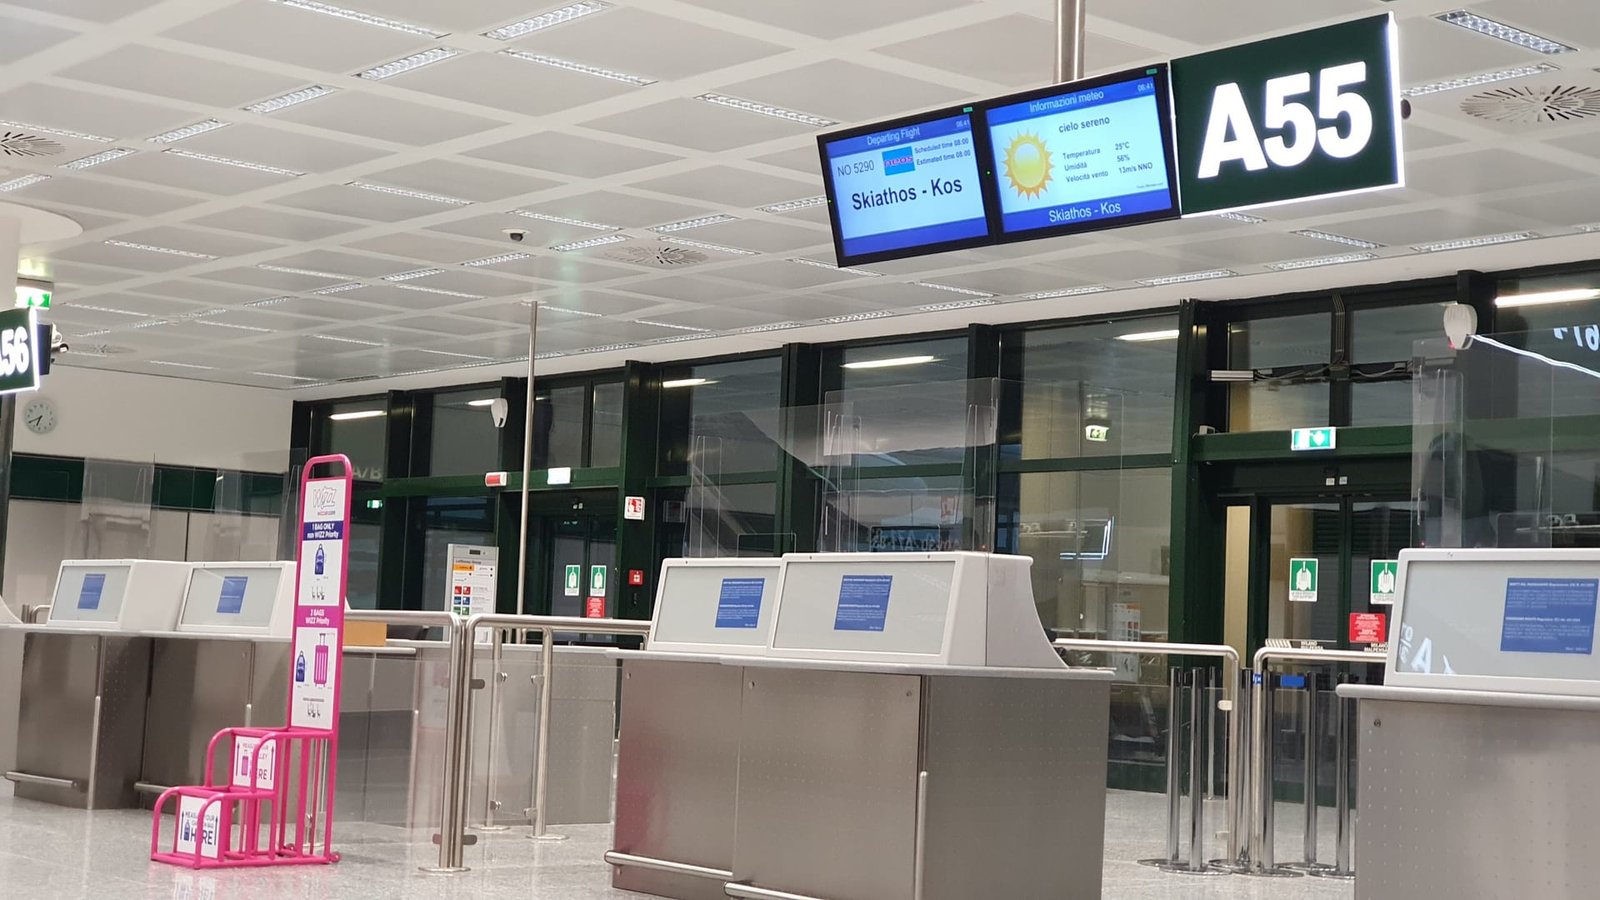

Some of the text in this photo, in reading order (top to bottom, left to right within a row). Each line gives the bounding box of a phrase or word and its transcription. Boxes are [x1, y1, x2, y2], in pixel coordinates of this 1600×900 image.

[1030, 90, 1104, 113] Informazioni meteo
[1059, 117, 1111, 133] cielo sereno
[1198, 61, 1373, 179] A55
[867, 127, 920, 146] Departing Flight
[914, 143, 941, 154] Scheduled
[1062, 141, 1130, 160] Temperatura 25°C
[837, 159, 875, 177] NO 5290
[916, 154, 942, 165] Estimated
[1064, 160, 1088, 171] Umidità
[1066, 172, 1091, 182] Velocità
[1091, 170, 1109, 178] vento
[1138, 161, 1153, 171] NNO
[851, 186, 917, 210] Skiathos
[931, 178, 963, 197] Kos
[1049, 206, 1092, 223] Skiathos
[1101, 201, 1122, 215] Kos
[0, 326, 30, 377] 56
[190, 827, 213, 845] HRE
